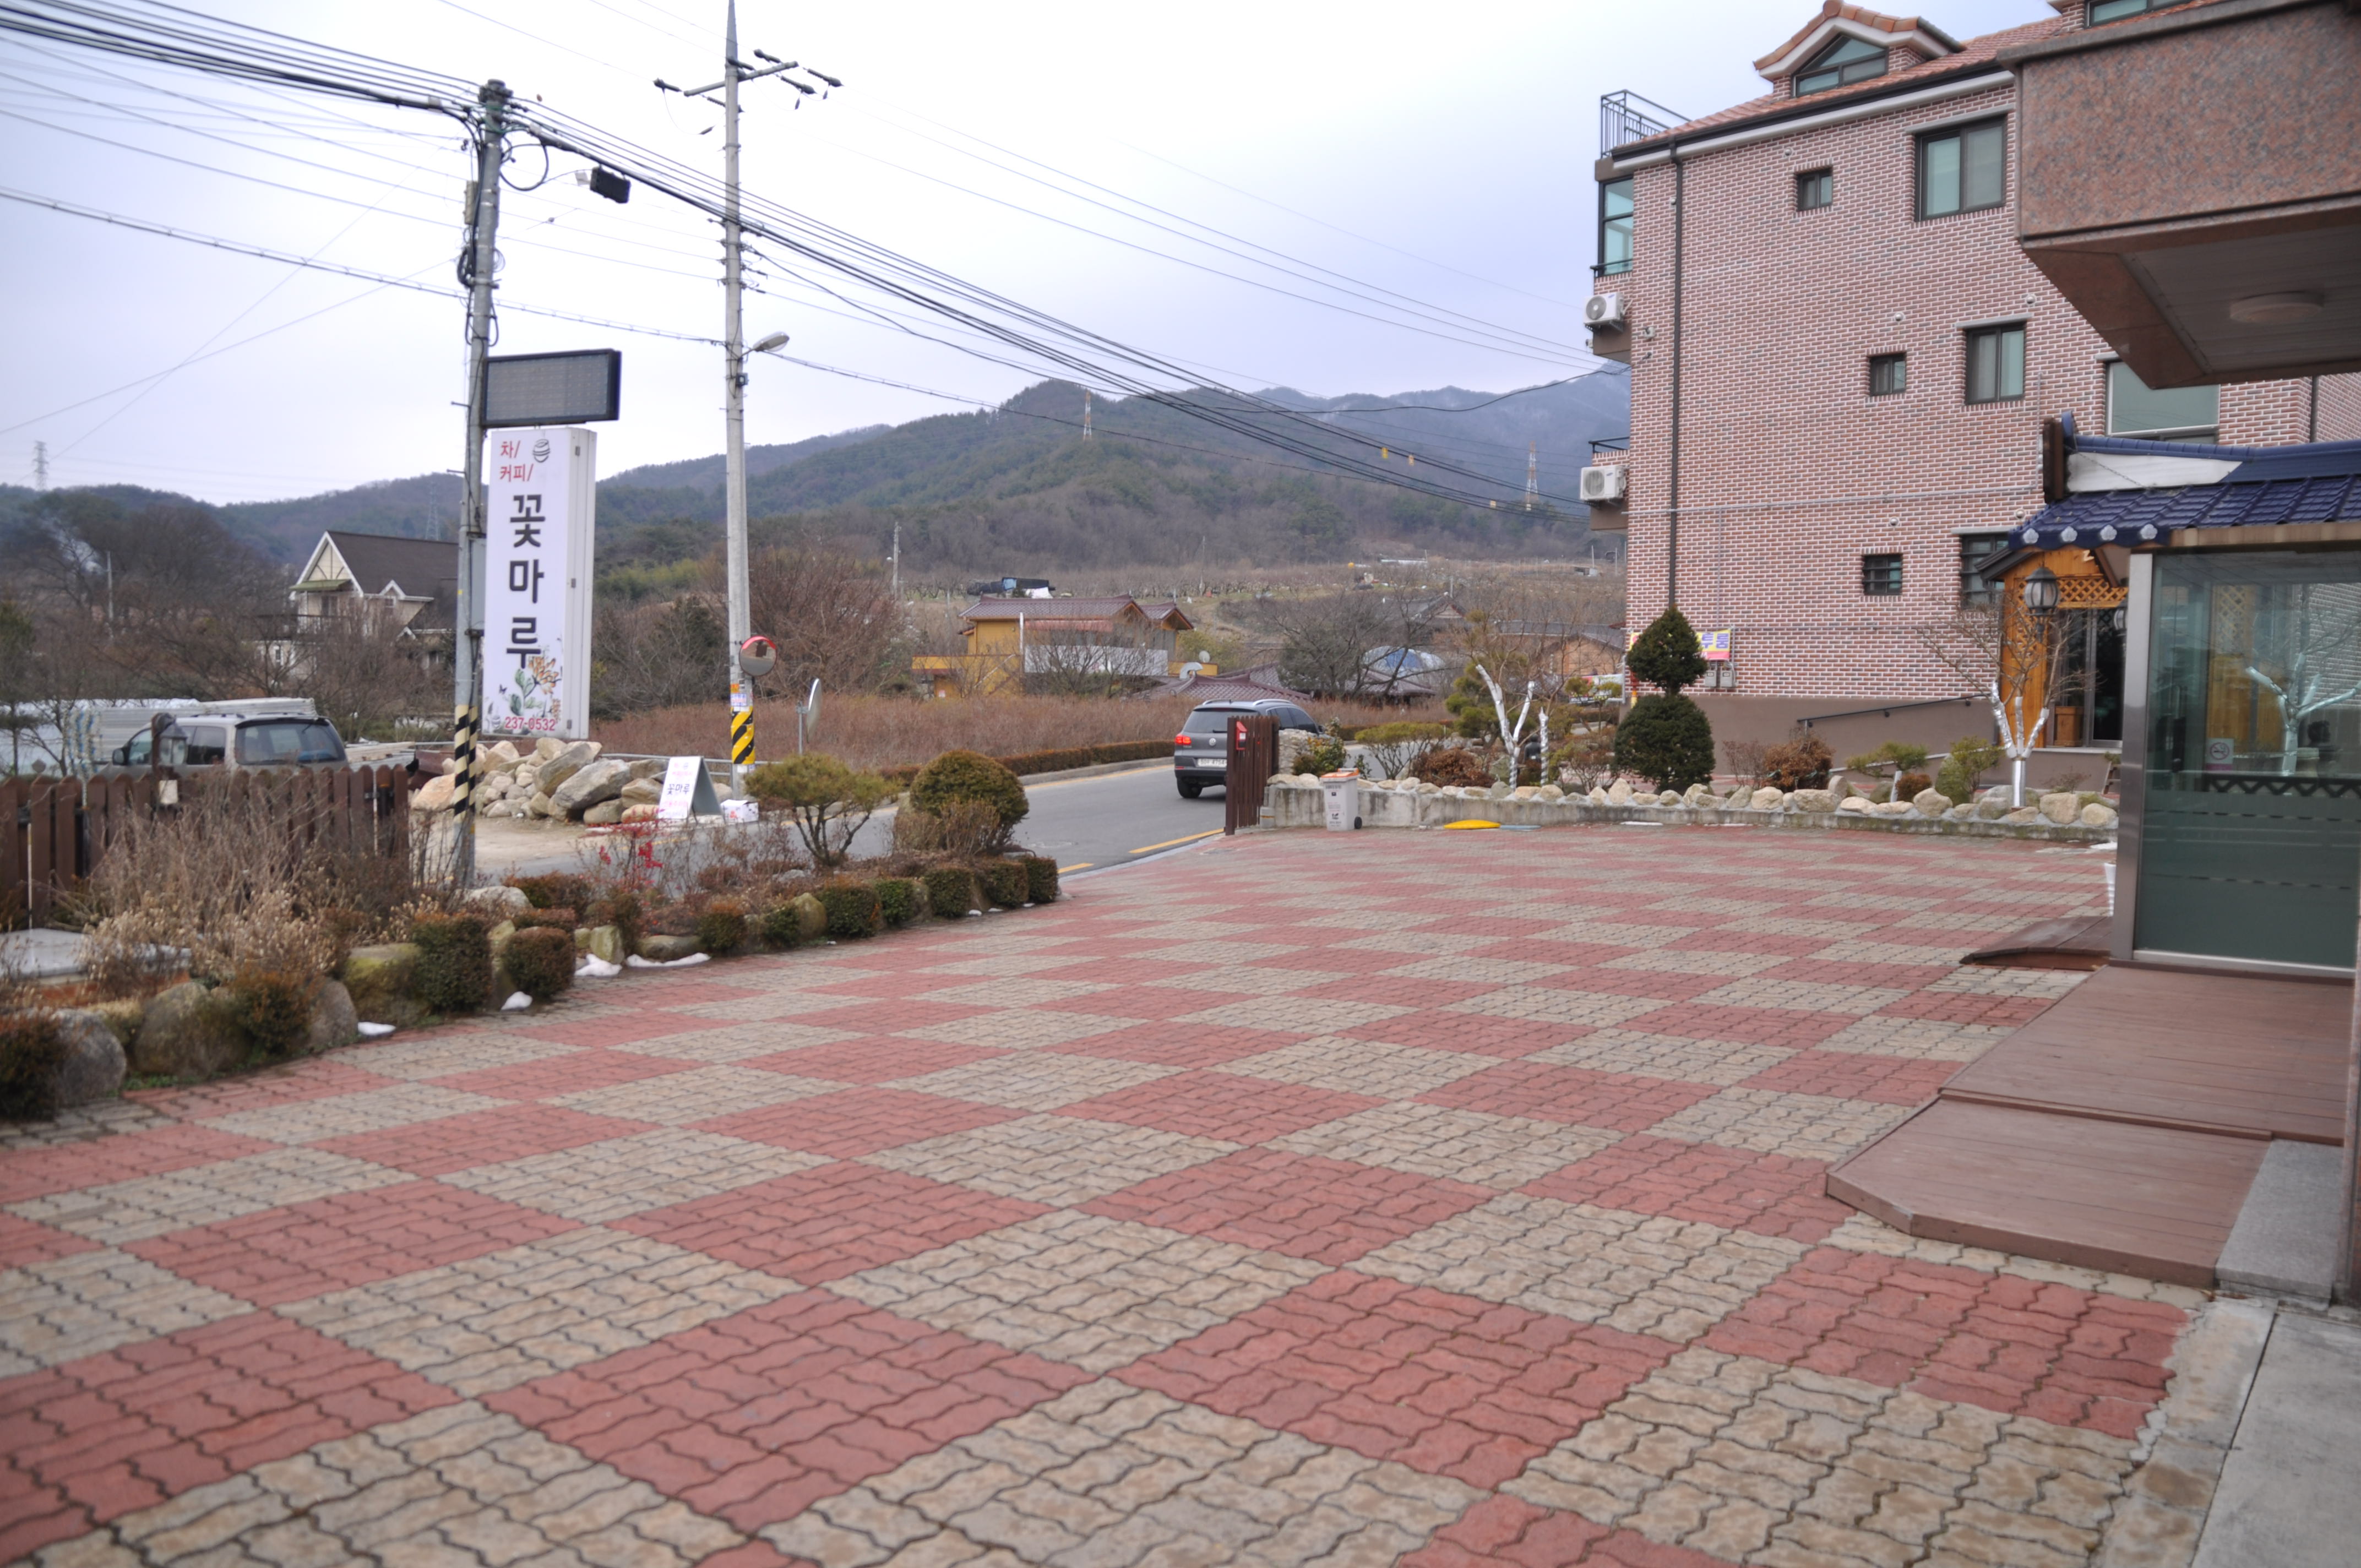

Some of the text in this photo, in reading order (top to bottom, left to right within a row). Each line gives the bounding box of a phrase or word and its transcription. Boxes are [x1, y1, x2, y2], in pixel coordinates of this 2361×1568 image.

[506, 494, 545, 669] 꽃마루
[505, 716, 556, 731] 237-0532
[667, 783, 690, 795] 꽃마루
